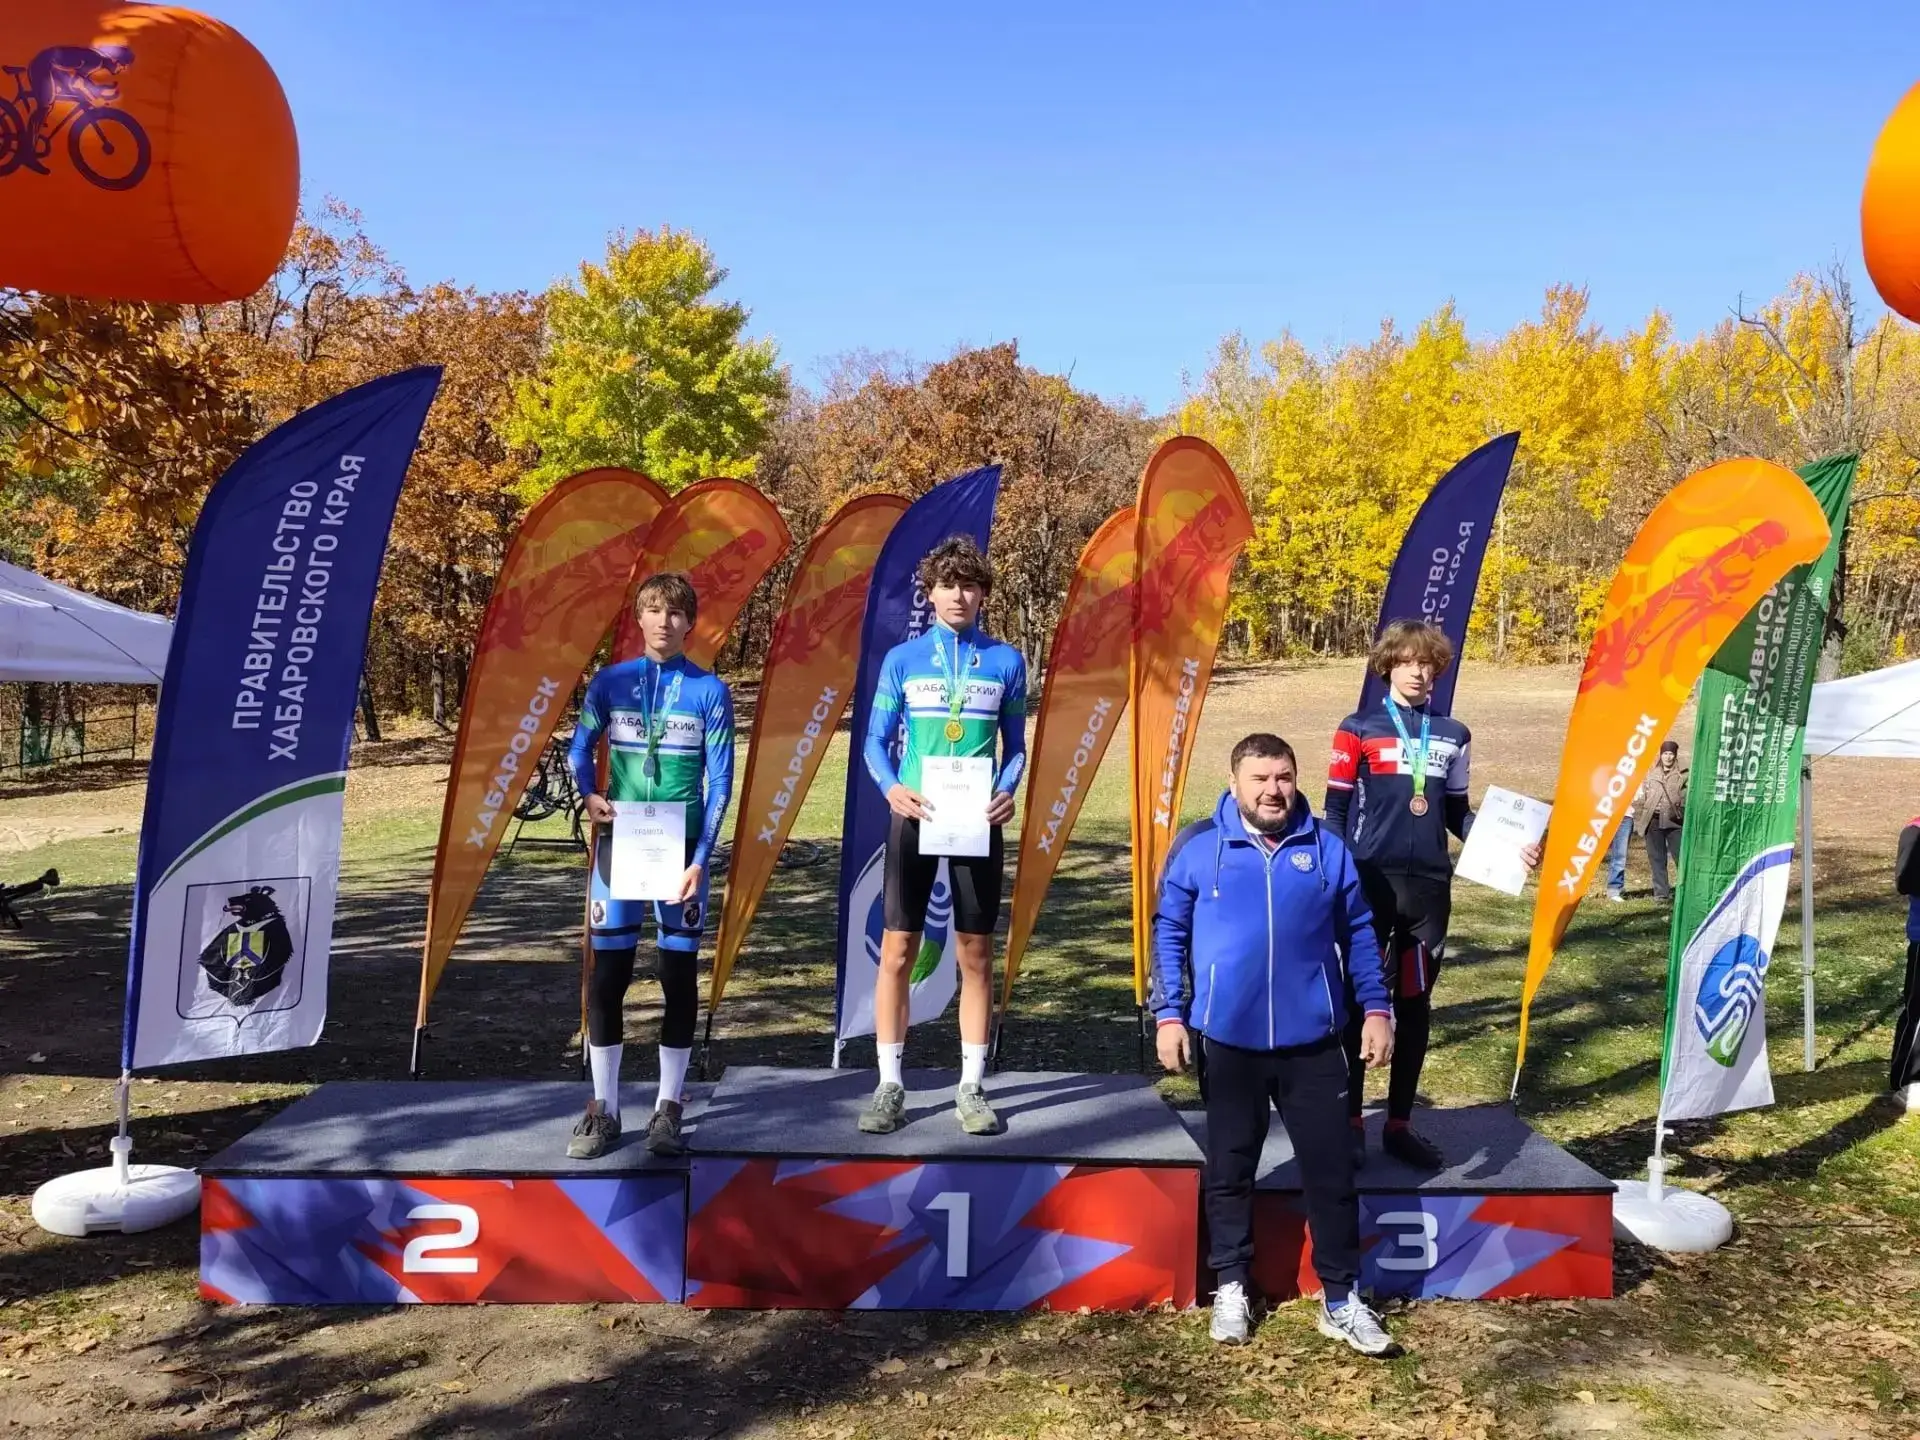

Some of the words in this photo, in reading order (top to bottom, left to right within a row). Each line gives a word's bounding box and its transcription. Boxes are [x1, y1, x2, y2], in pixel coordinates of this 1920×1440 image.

[232, 481, 318, 729] ПРАВИТЕЛЬСТВО
[268, 534, 338, 760] ХАБАРОВСКОГО
[320, 455, 366, 526] КРАЯ
[1445, 522, 1475, 585] КРАЯ
[465, 676, 560, 849] ХАБАРОВСК
[758, 685, 839, 846] ХАБАРОВСК
[1714, 693, 1738, 801] ЦЕНТР
[1743, 582, 1795, 804] ПОДГОТОВКИ
[1037, 697, 1113, 855] ХАБАРОВСК
[1557, 713, 1659, 896] ХАБАРОВСК
[402, 1203, 480, 1273] 2
[925, 1192, 970, 1277] 1
[1376, 1211, 1438, 1270] 3
